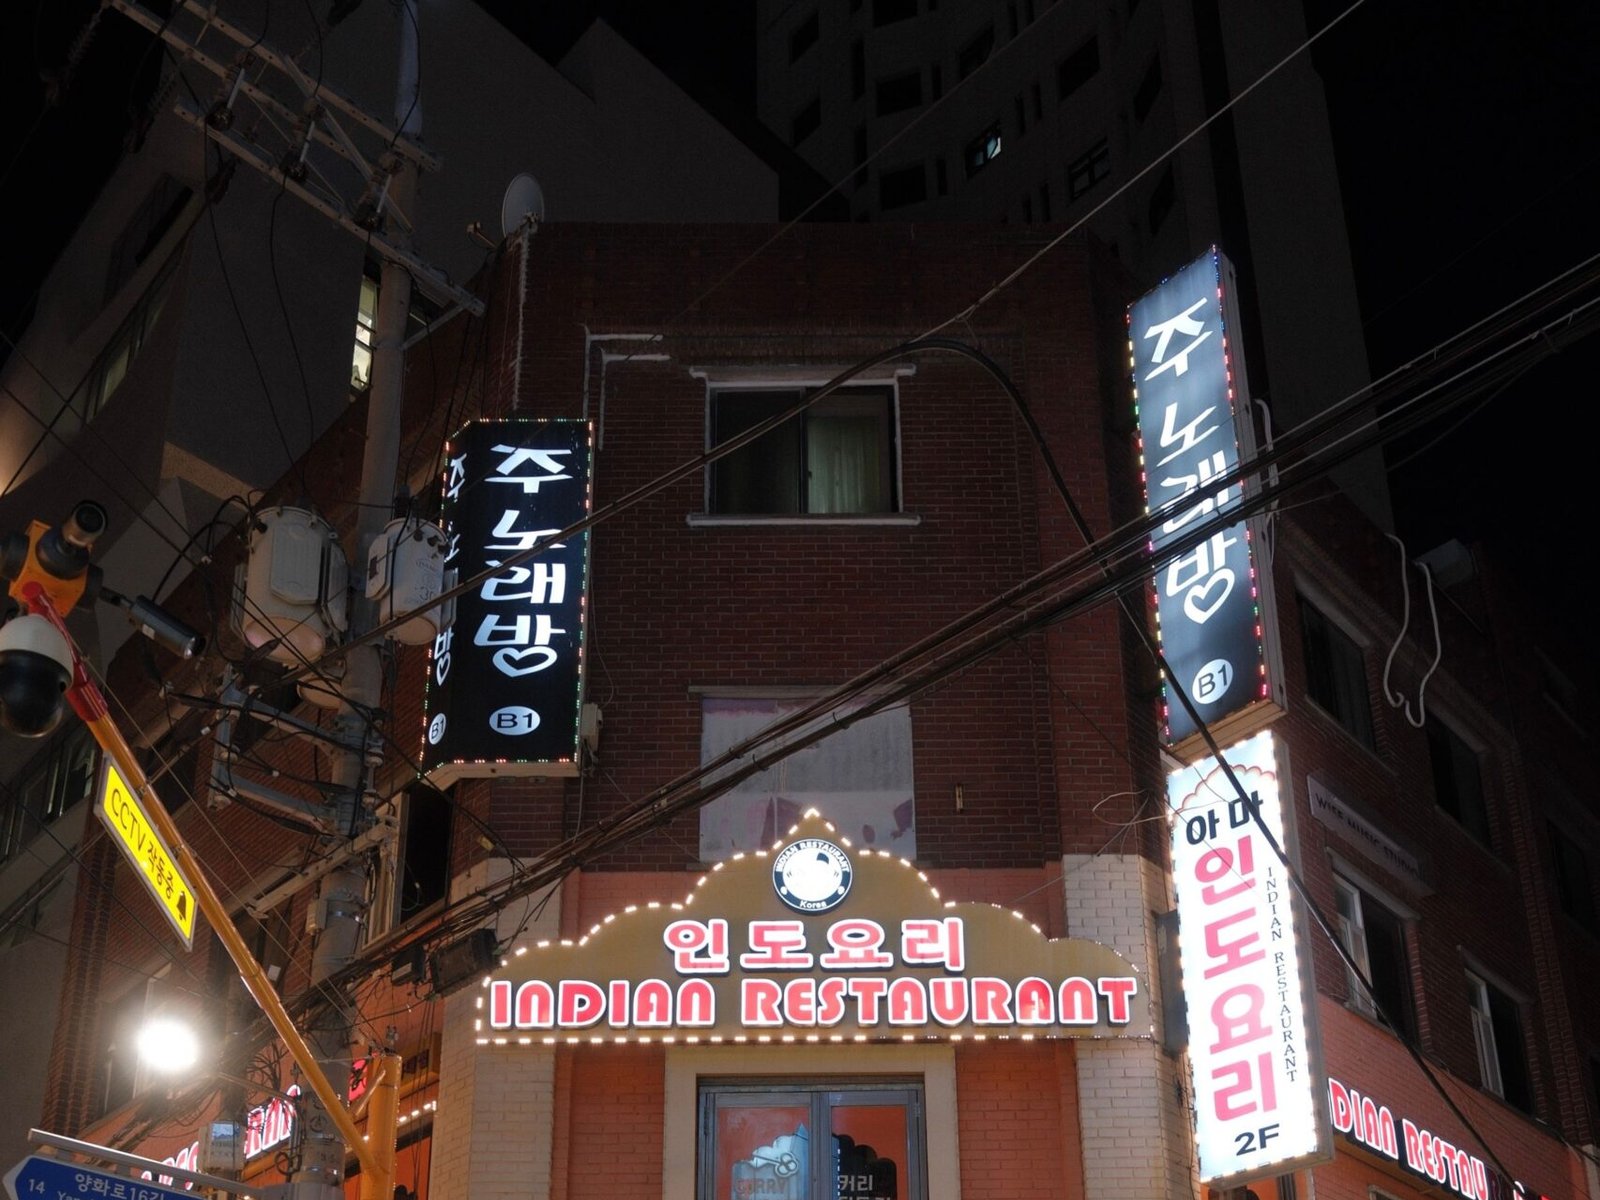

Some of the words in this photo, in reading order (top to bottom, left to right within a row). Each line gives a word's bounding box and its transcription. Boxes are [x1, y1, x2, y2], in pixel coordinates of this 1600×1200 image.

[1198, 663, 1230, 700] B1
[430, 722, 446, 741] B1
[497, 712, 534, 730] B1
[111, 788, 147, 852] CCTV
[147, 841, 175, 901] 작동중
[775, 845, 799, 873] INDIAN
[799, 840, 852, 873] RESTAURANT
[799, 900, 828, 909] Korea
[1266, 866, 1283, 942] INDIAN
[663, 916, 966, 975] 인도요리
[1194, 835, 1279, 1123] 인도요리
[490, 978, 717, 1029] INDIAN
[740, 976, 1137, 1026] RESTAURANT
[1274, 951, 1298, 1083] RESTAURANT
[1328, 1077, 1399, 1160] DIAN
[1234, 1123, 1281, 1156] 2F
[27, 1178, 46, 1195] 14
[839, 1174, 874, 1192] 커리
